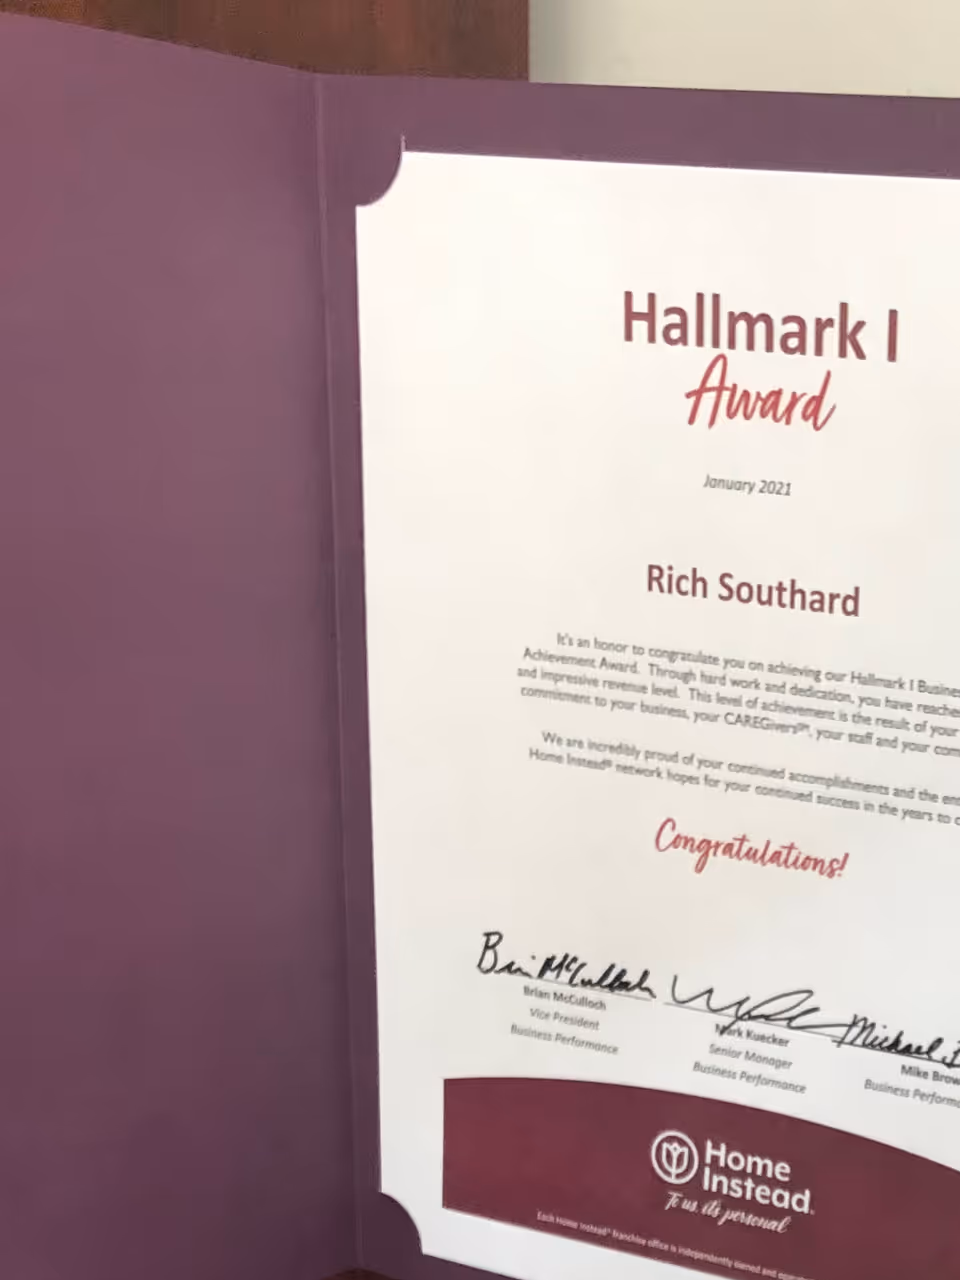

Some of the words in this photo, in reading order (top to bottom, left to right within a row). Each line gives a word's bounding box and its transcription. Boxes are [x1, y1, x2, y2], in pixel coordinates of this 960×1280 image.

[623, 290, 866, 360] Hallmark
[887, 309, 898, 362] I
[685, 353, 836, 431] Award
[703, 474, 755, 495] January
[758, 479, 792, 496] 2021
[647, 564, 707, 599] Rich
[718, 572, 860, 617] Southard
[523, 647, 596, 668] Achievement
[600, 657, 640, 674] Award.
[649, 663, 696, 683] Through
[701, 673, 726, 686] hard
[731, 677, 760, 691] work
[765, 681, 785, 694] and
[858, 695, 880, 707] you
[885, 696, 912, 711] have
[557, 633, 573, 647] It's
[577, 637, 590, 648] an
[594, 637, 628, 654] honor
[632, 644, 644, 656] to
[649, 648, 720, 667] congratulate
[723, 657, 745, 670] you
[750, 660, 764, 671] on
[768, 661, 821, 682] achieving
[825, 670, 846, 682] our
[851, 671, 904, 690] Hallmark
[517, 666, 537, 679] and
[541, 670, 599, 688] impressive
[603, 679, 648, 693] revenue
[652, 683, 680, 698] level.
[689, 687, 712, 703] This
[716, 692, 742, 707] level
[745, 696, 759, 709] of
[761, 698, 835, 720] achievement
[840, 710, 848, 722] is
[852, 713, 871, 726] the
[875, 716, 910, 731] result
[914, 720, 927, 733] of
[930, 725, 959, 738] your
[521, 685, 591, 705] commitment
[595, 694, 607, 707] to
[610, 699, 636, 711] your
[640, 700, 689, 720] business,
[693, 710, 720, 723] your
[816, 727, 844, 740] your
[848, 731, 874, 745] staff
[876, 736, 898, 749] and
[902, 740, 930, 753] your
[529, 748, 564, 765] Home
[616, 762, 662, 779] network
[667, 768, 700, 786] hopes
[704, 774, 720, 788] for
[724, 781, 750, 793] your
[755, 784, 813, 803] continued
[817, 794, 860, 811] success
[864, 800, 874, 813] in
[879, 802, 898, 816] the
[902, 808, 933, 822] years
[937, 811, 951, 824] to
[542, 731, 562, 747] We
[566, 737, 584, 749] are
[588, 739, 641, 760] incredibly
[645, 748, 678, 764] proud
[682, 753, 694, 766] of
[697, 758, 723, 770] your
[728, 761, 785, 779] continued
[789, 770, 889, 796] accomplishments
[893, 787, 915, 800] and
[918, 789, 938, 803] the
[655, 817, 849, 879] Congratulations!
[523, 985, 550, 1000] Brian
[553, 991, 606, 1010] McCulloch
[530, 1008, 550, 1021] Vice
[553, 1011, 600, 1031] President
[511, 1022, 551, 1041] Business
[555, 1033, 619, 1055] Performance
[709, 1043, 742, 1059] Senior
[744, 1050, 793, 1070] Manager
[746, 1029, 790, 1048] Kuecker
[693, 1061, 737, 1080] Business
[739, 1071, 807, 1094] Performance
[864, 1079, 910, 1098] Business
[900, 1064, 929, 1080] Mike
[705, 1139, 791, 1182] Home
